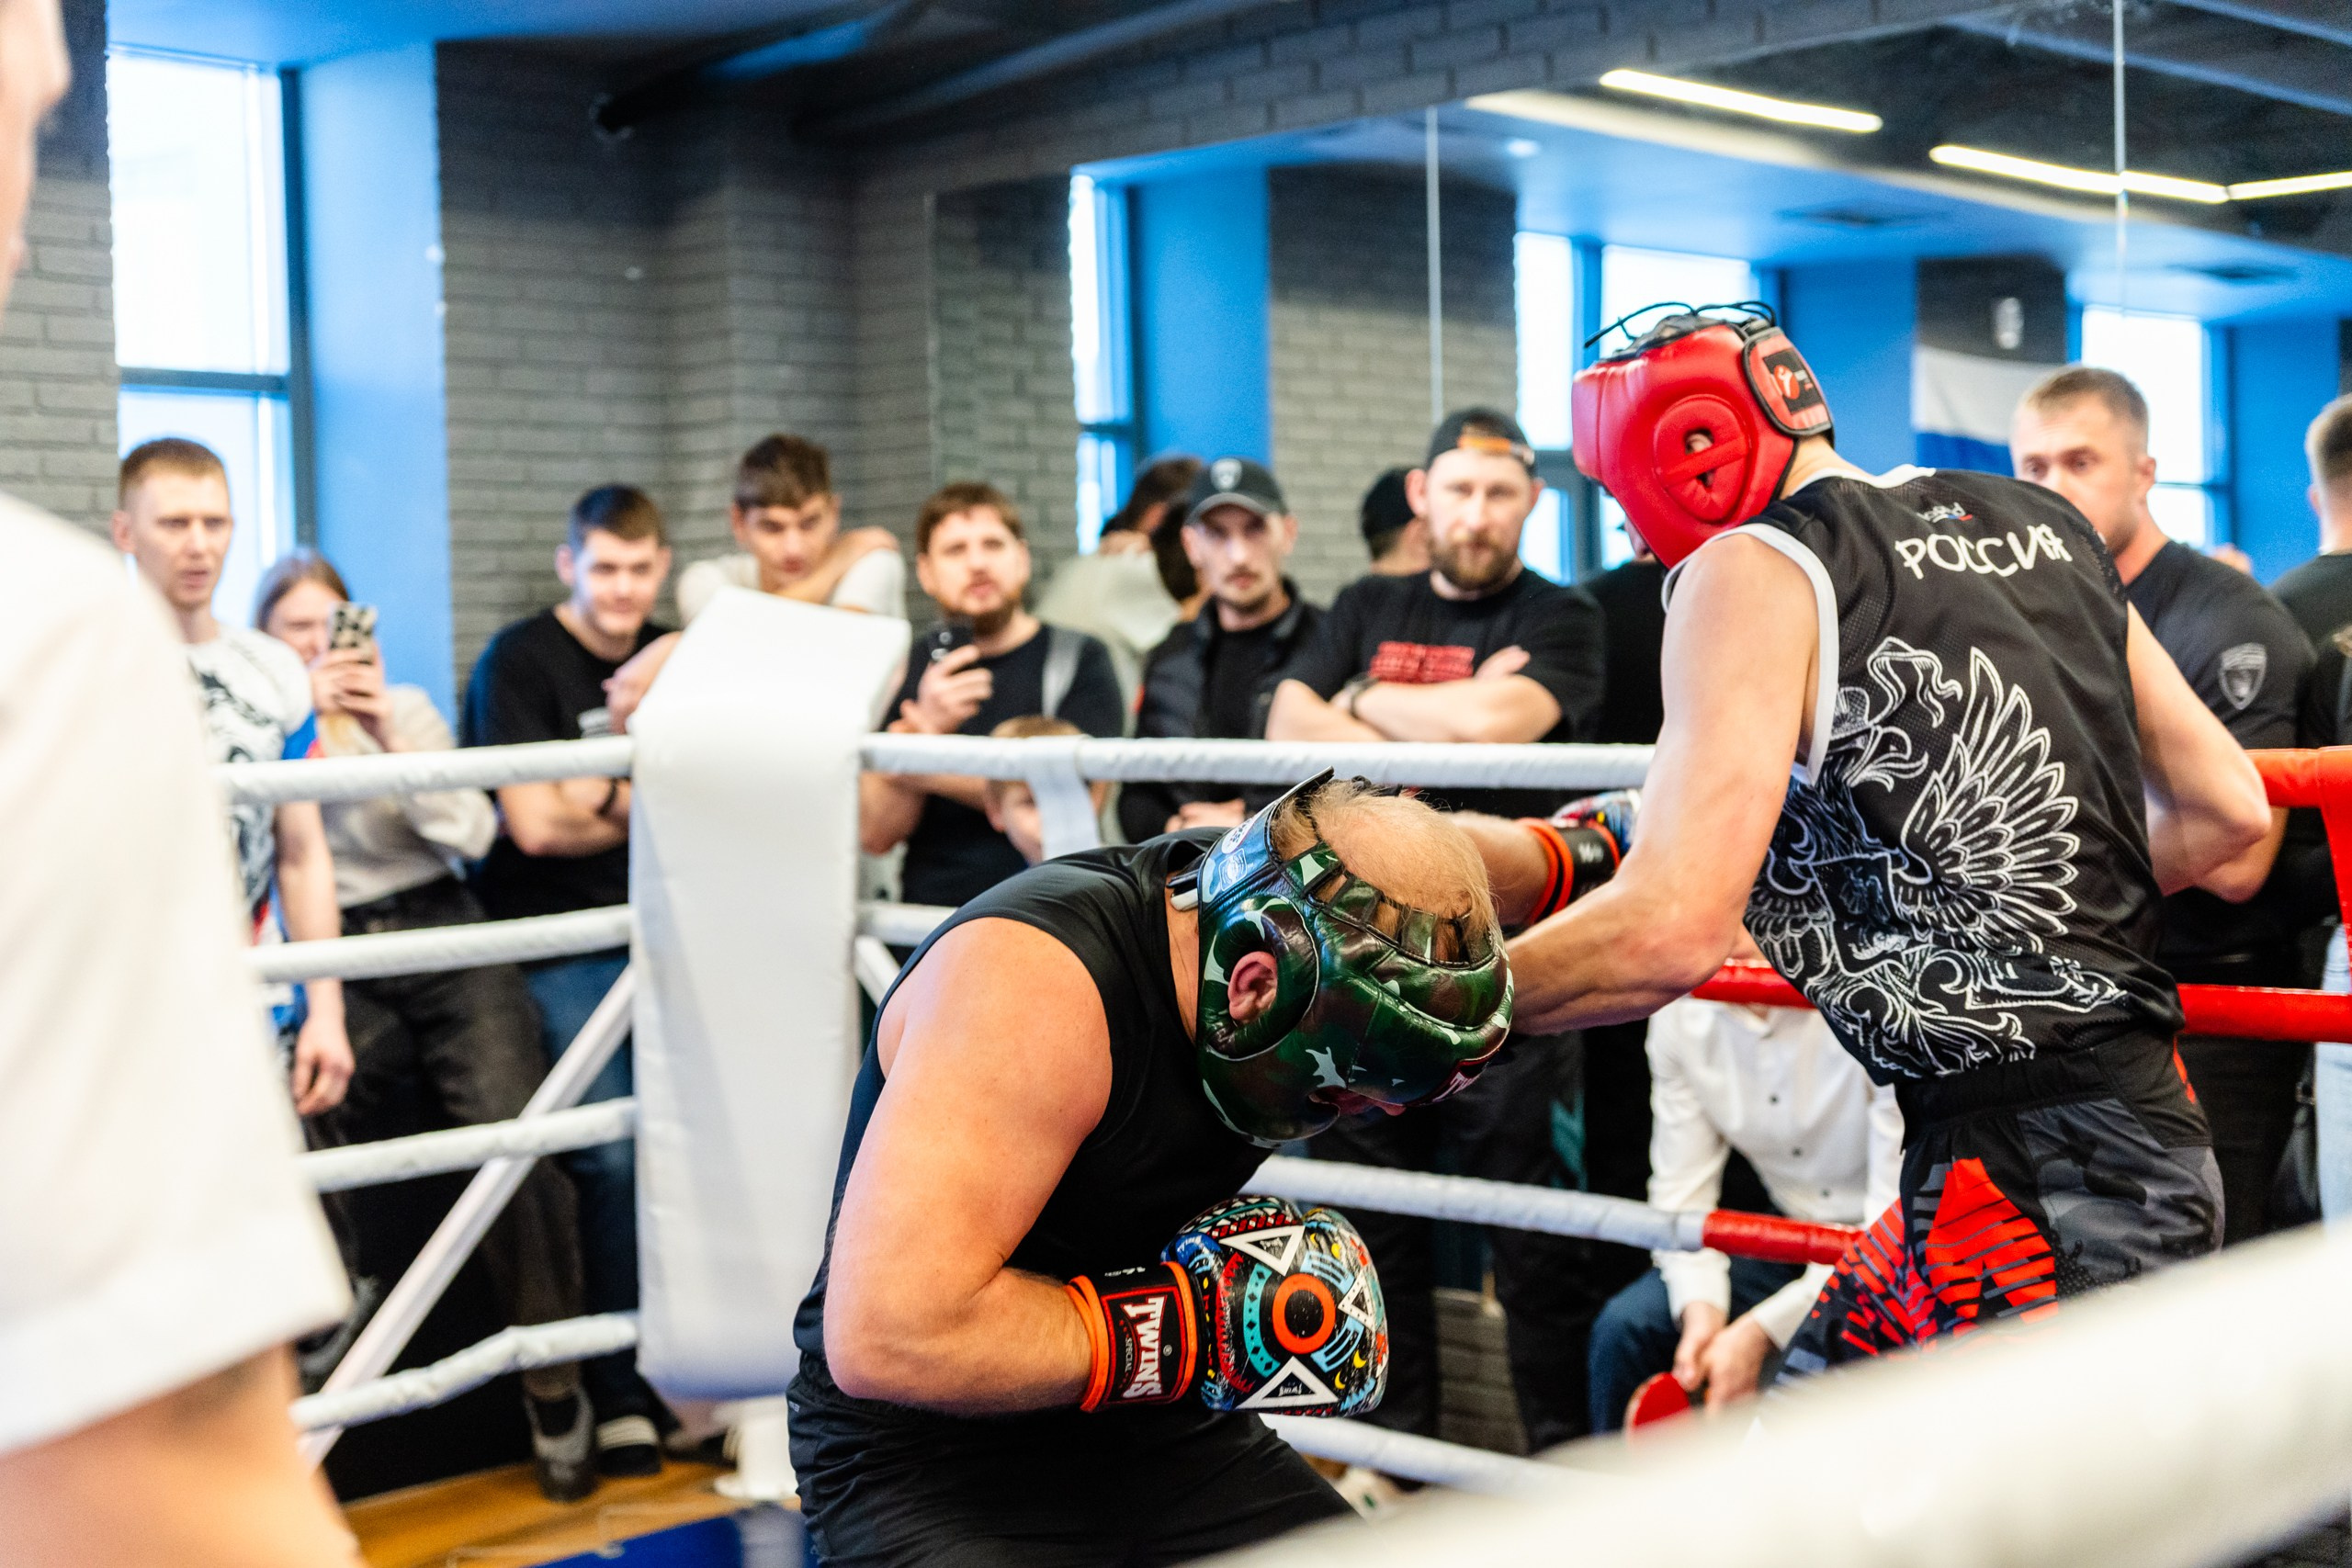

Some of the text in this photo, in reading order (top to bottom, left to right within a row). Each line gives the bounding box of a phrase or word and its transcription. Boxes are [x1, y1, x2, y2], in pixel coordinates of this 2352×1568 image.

[1894, 523, 2073, 580] РОССИЯ
[1121, 1295, 1167, 1399] TWINS
[1125, 1337, 1134, 1372] SPECIAL
